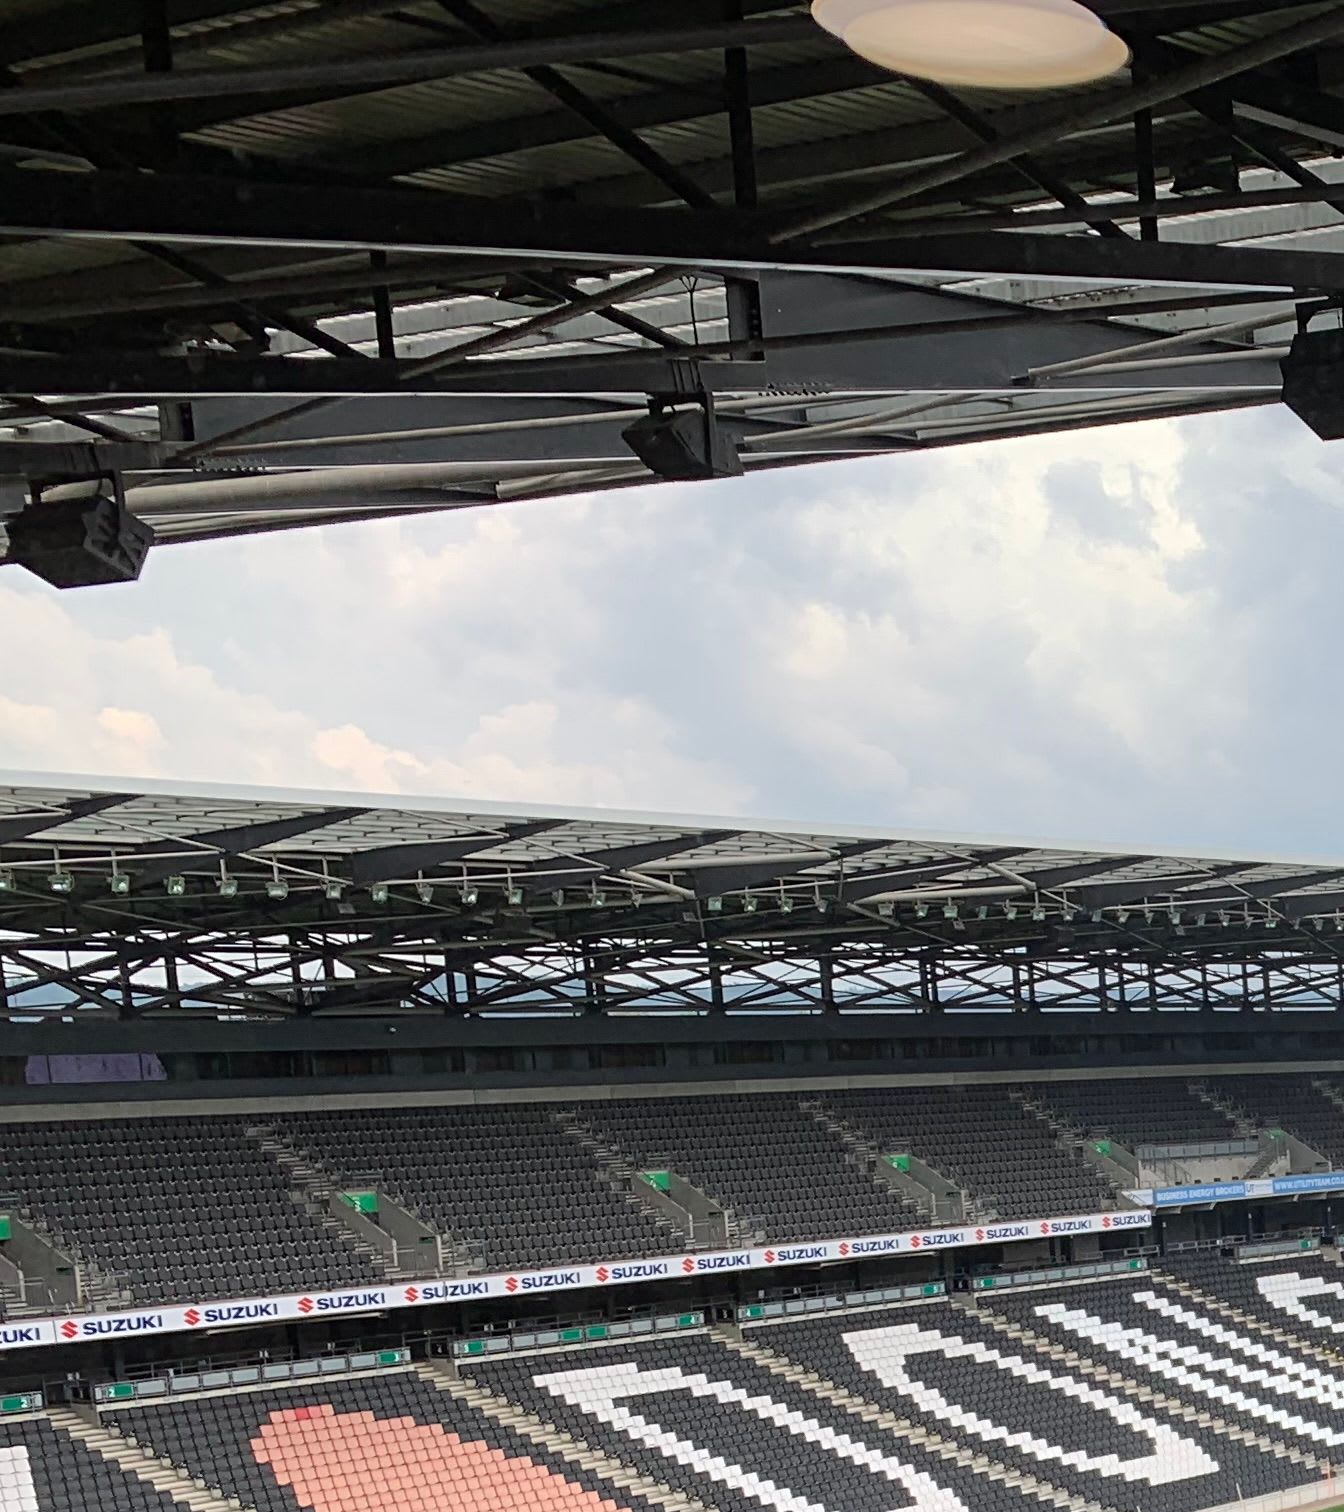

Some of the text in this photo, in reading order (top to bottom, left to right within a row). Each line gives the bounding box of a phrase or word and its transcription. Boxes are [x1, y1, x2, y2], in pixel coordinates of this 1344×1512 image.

[1051, 1219, 1092, 1232] SUZUKI
[1112, 1213, 1151, 1226] SUZUKI
[922, 1232, 964, 1246] SUZUKI
[987, 1225, 1029, 1239] SUZUKI
[778, 1246, 827, 1261] SUZUKI
[852, 1239, 900, 1253] SUZUKI
[697, 1254, 750, 1270] SUZUKI
[612, 1263, 668, 1279] SUZUKI
[522, 1271, 581, 1290] SUZUKI
[422, 1282, 489, 1300] SUZUKI
[317, 1292, 386, 1310] SUZUKI
[204, 1303, 279, 1323] SUZUKI
[83, 1315, 163, 1336] SUZUKI
[0, 1327, 41, 1344] UKI
[21, 1396, 28, 1408] 2
